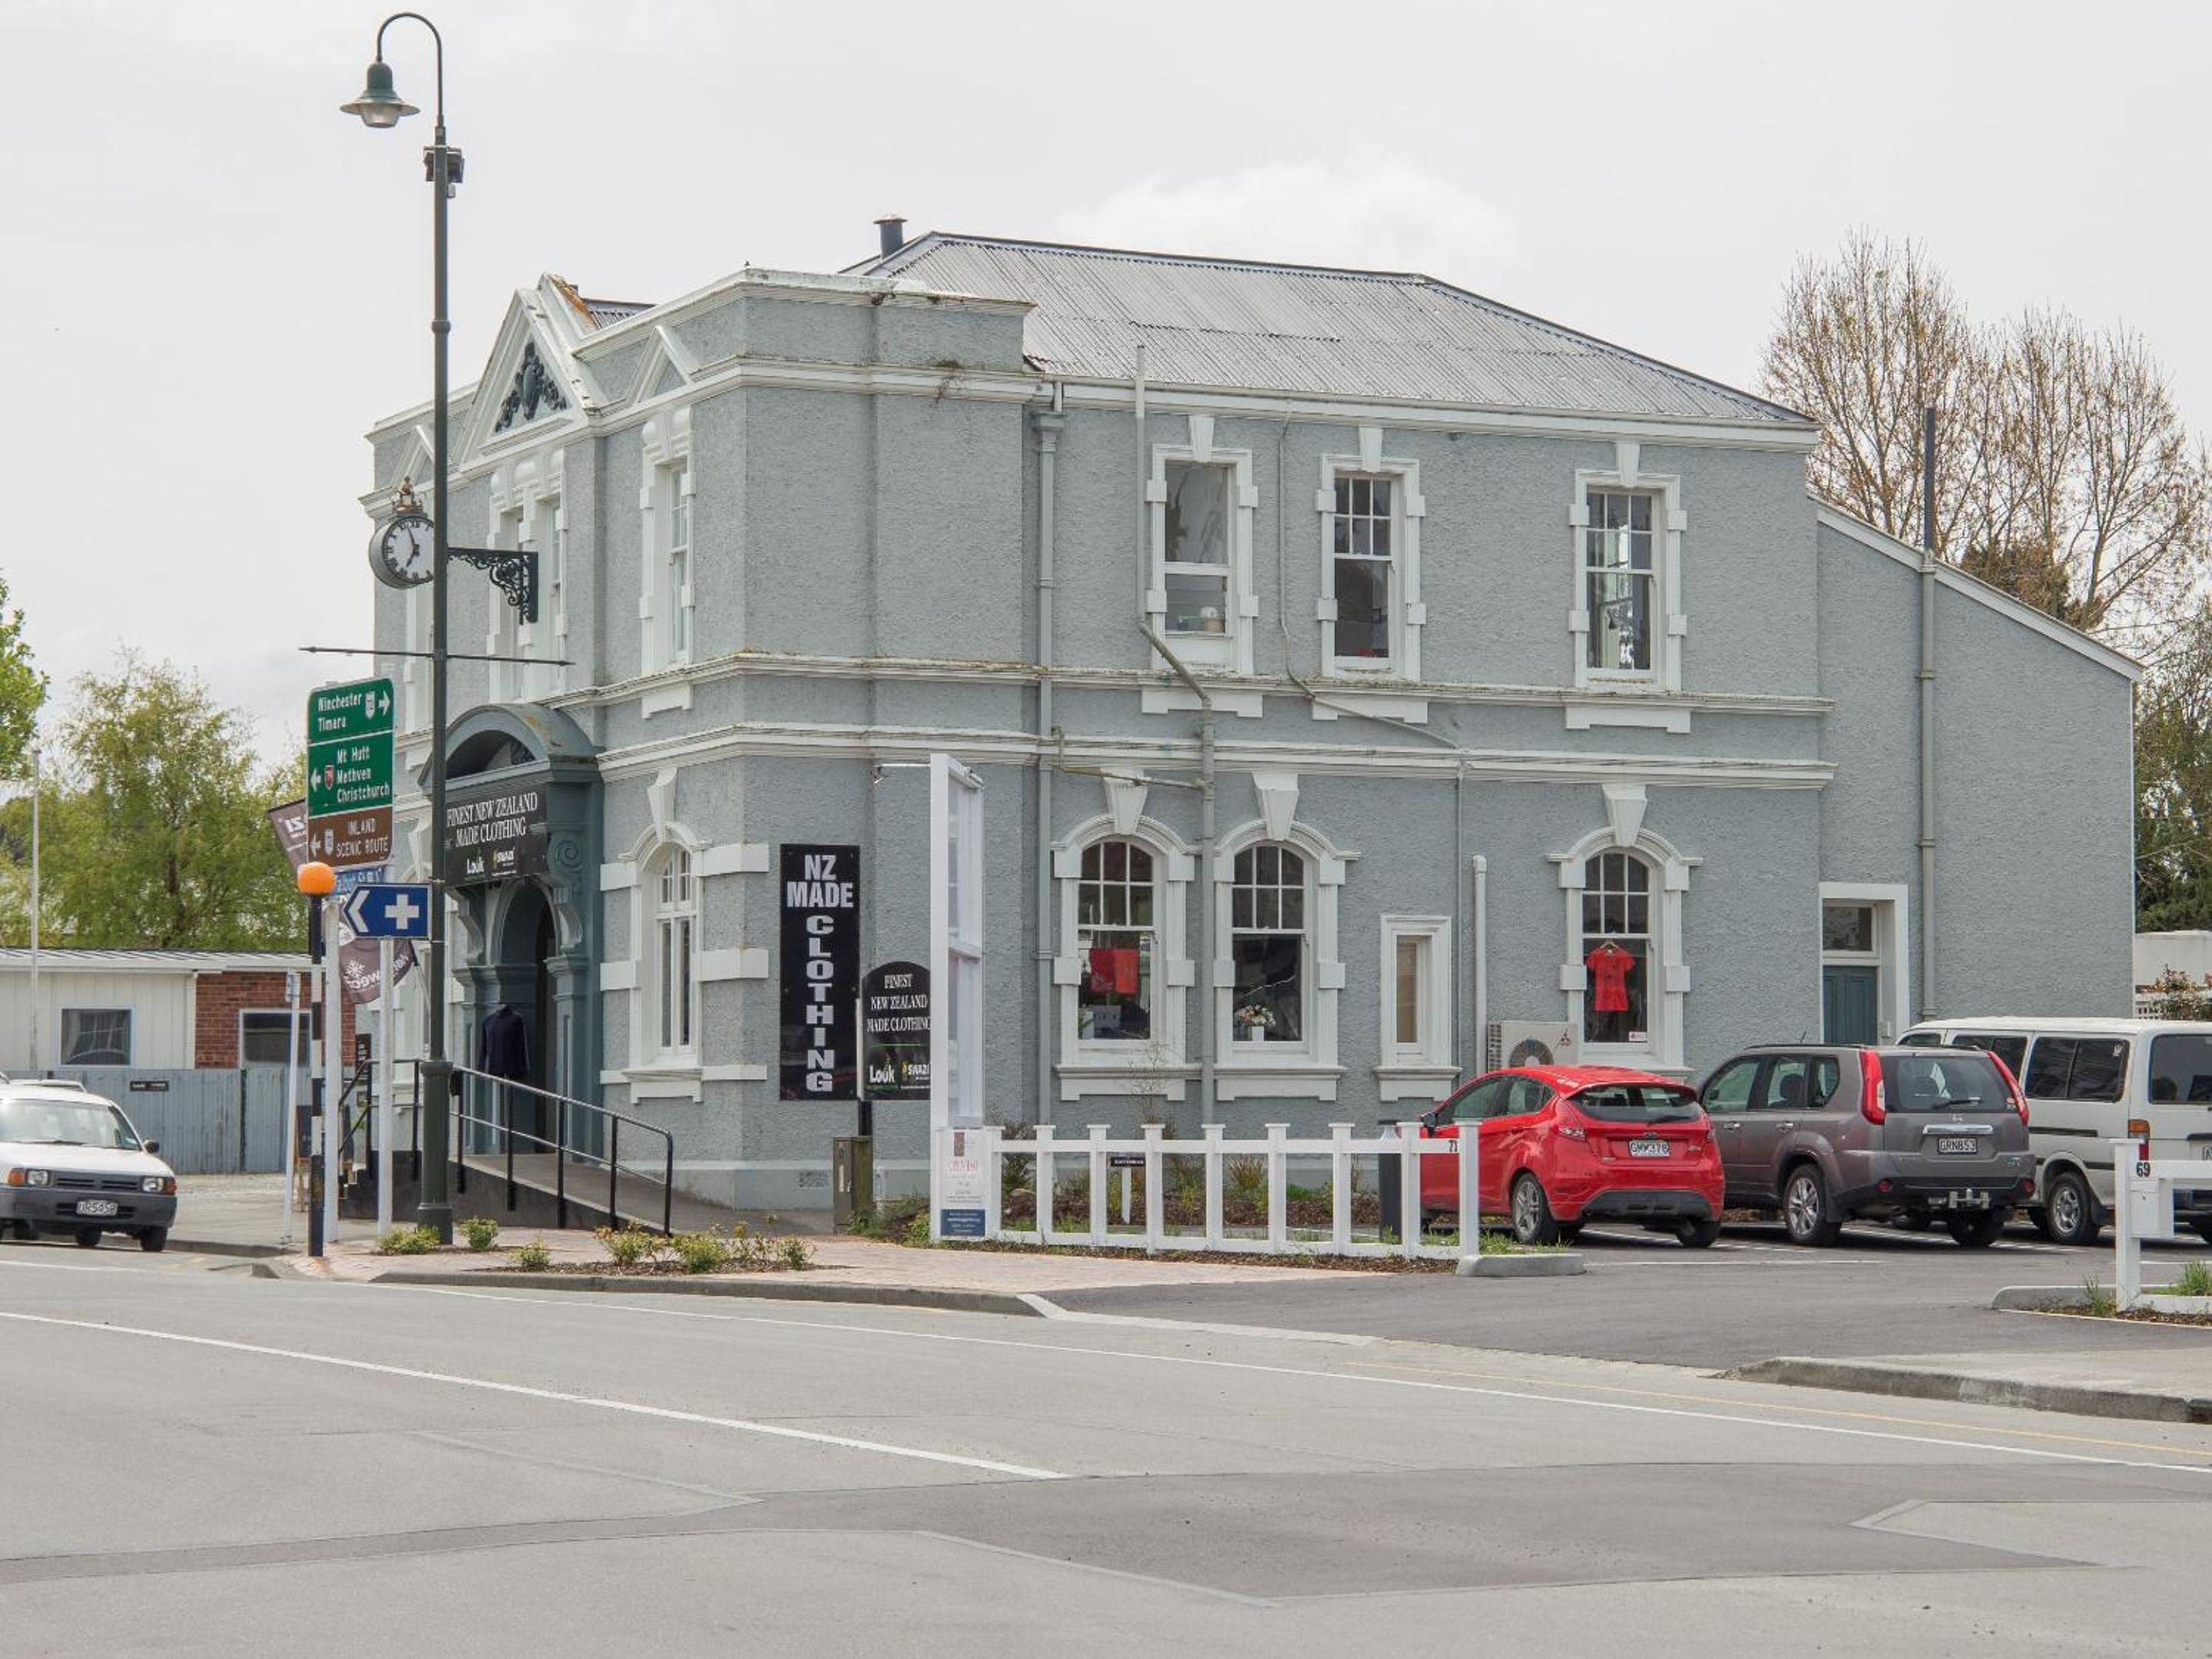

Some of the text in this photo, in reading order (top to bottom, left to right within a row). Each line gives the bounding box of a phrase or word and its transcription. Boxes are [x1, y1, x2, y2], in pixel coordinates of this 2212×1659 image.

[318, 692, 362, 711] Winchester
[318, 716, 346, 732] Timaru
[336, 744, 370, 764] Mt Hutt
[336, 767, 371, 784] Methven
[337, 781, 390, 803] Christchurch
[446, 791, 538, 827] FINEST NEW ZEALAND
[348, 818, 376, 836] INLAND
[455, 816, 526, 847] MADE CLOTHING
[365, 835, 389, 854] ROUTE
[804, 855, 836, 881] NZ
[786, 882, 853, 908] MADE
[884, 974, 913, 989] FINEST
[806, 915, 835, 1092] CLOTHING
[871, 995, 928, 1011] NEW ZEALAND
[867, 1018, 889, 1033] MADE
[2136, 1161, 2151, 1177] 69
